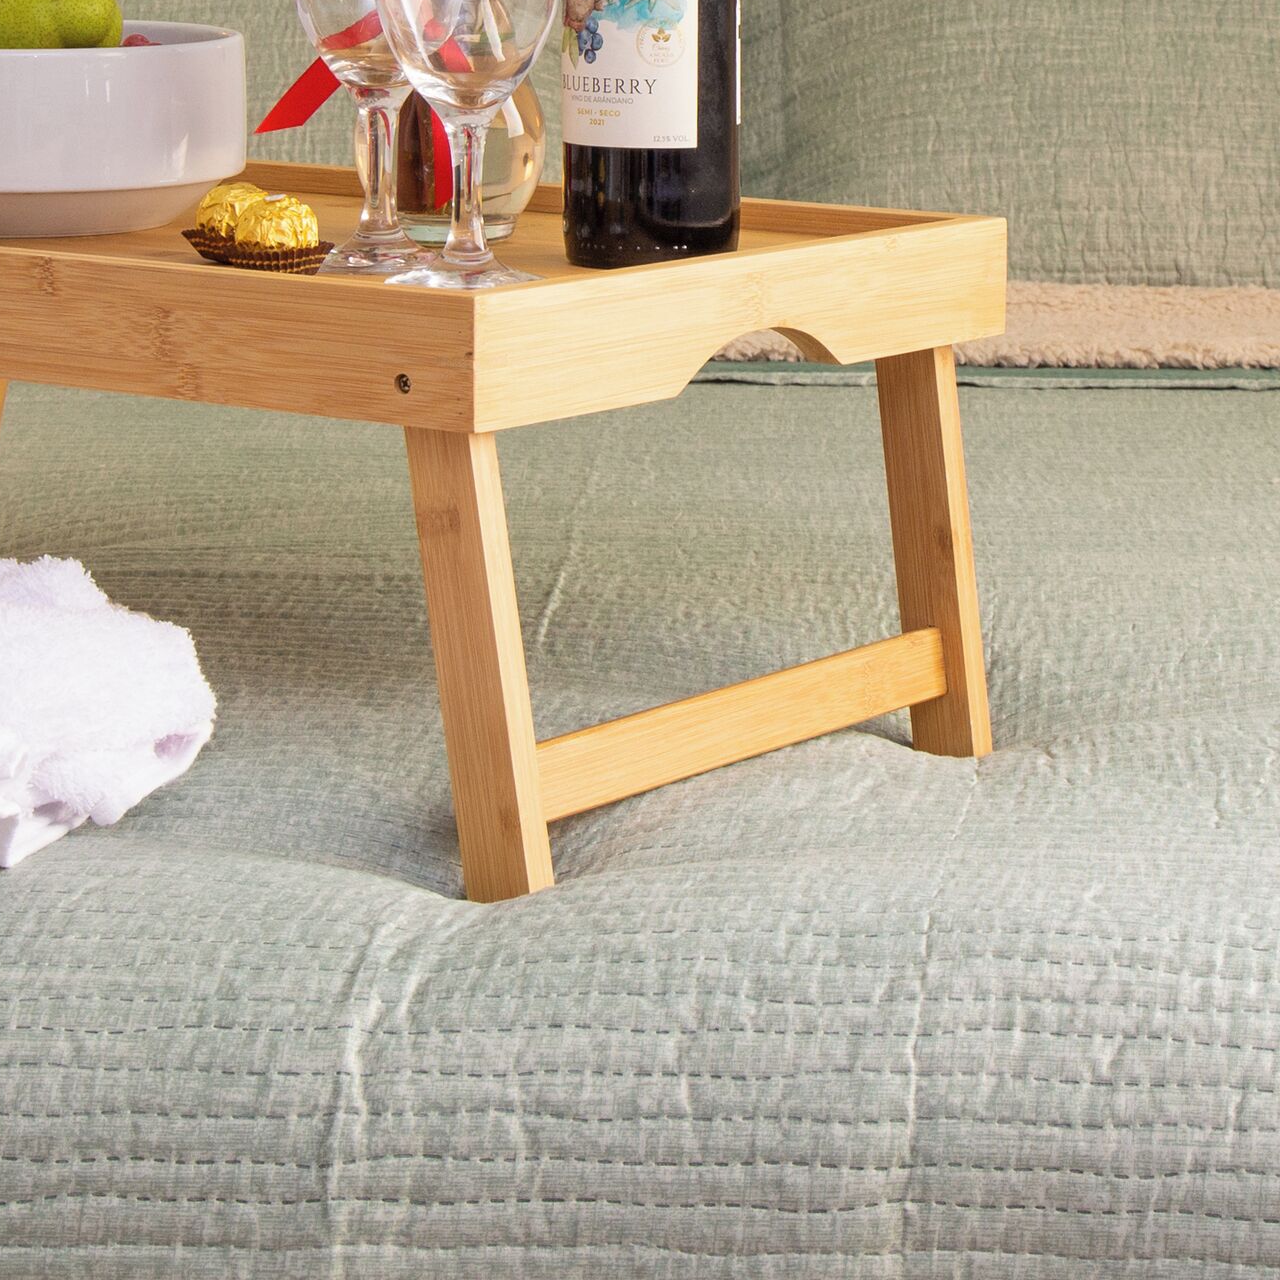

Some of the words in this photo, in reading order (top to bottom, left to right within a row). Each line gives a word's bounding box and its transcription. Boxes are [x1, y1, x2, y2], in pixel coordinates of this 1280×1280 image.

[562, 74, 658, 94] BLUEBERRY
[577, 107, 593, 116] SEMI
[599, 109, 621, 118] SECO
[589, 118, 605, 126] 2021
